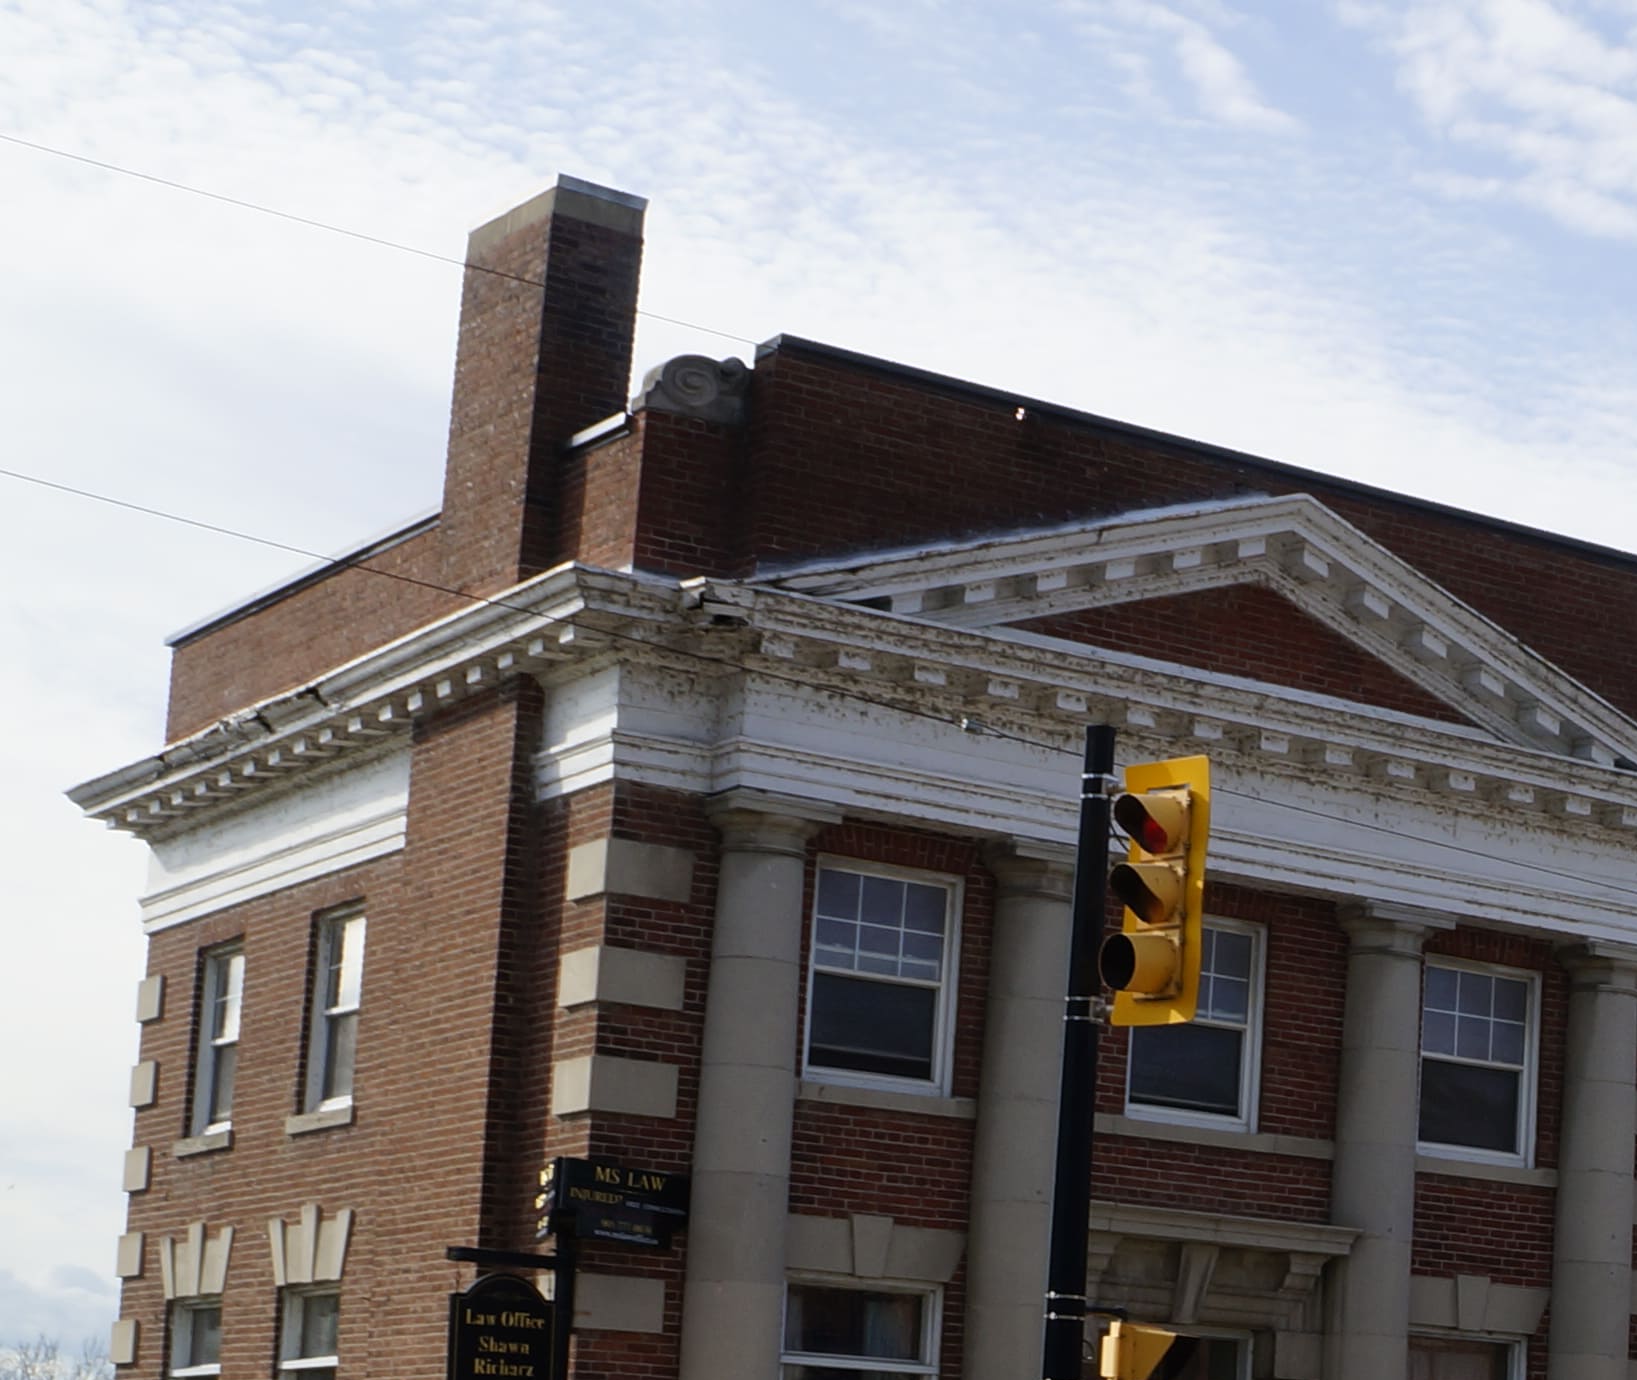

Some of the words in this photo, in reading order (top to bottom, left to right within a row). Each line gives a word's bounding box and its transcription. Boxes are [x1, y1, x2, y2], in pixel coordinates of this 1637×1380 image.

[594, 1164, 621, 1185] MS
[626, 1170, 667, 1192] LAW
[465, 1307, 497, 1326] Law
[500, 1310, 545, 1329] Office
[477, 1335, 531, 1356] Shawn
[473, 1357, 535, 1377] Richarz
